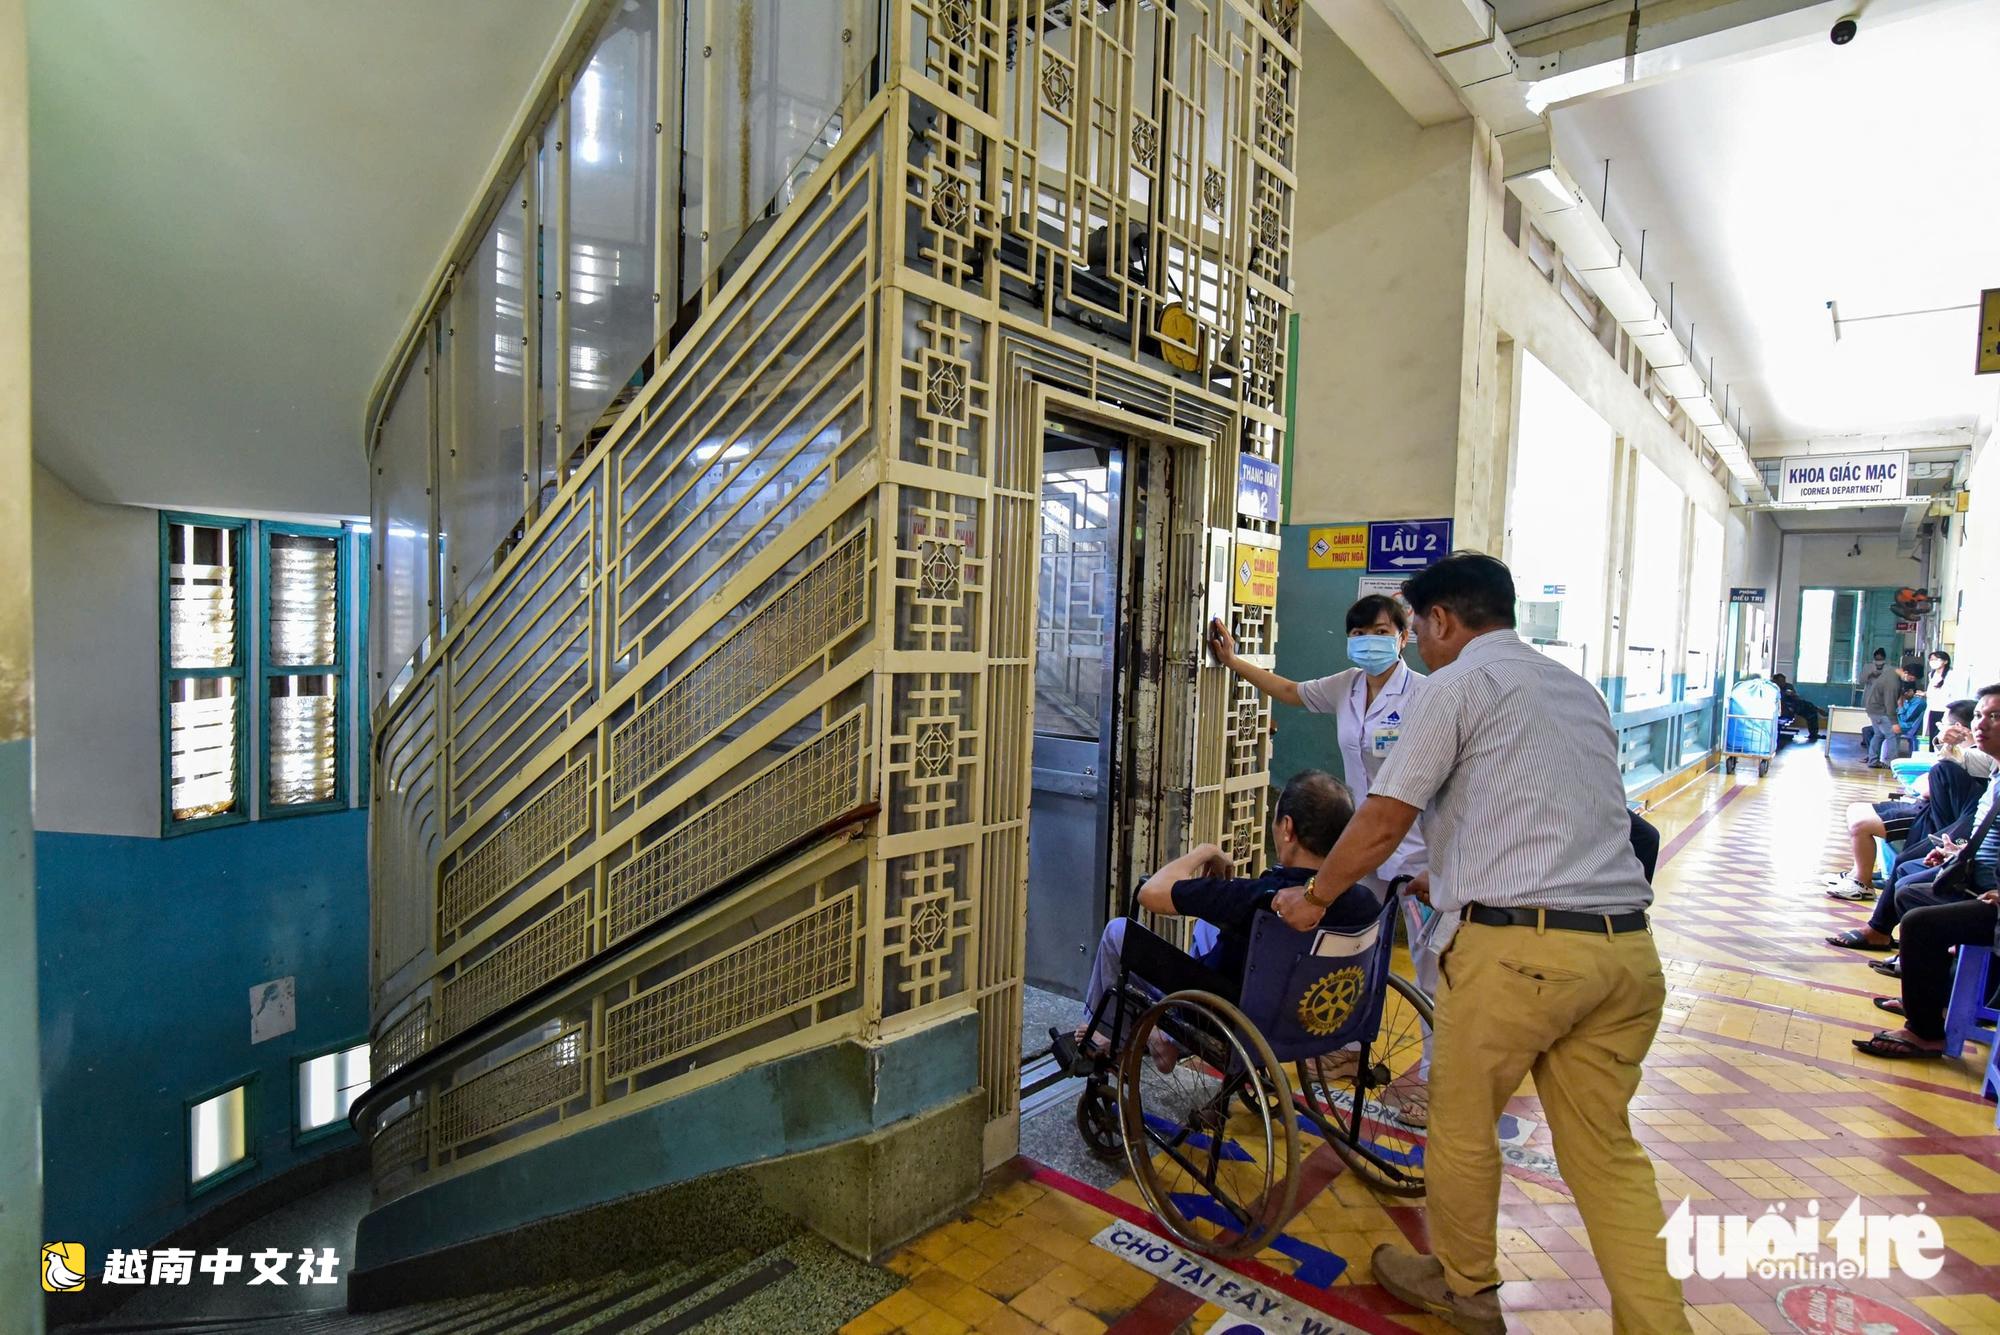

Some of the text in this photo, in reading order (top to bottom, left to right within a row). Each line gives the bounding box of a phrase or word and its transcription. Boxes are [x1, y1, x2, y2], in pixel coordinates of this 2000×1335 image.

[1243, 464, 1278, 488] THANG MÁY
[1789, 462, 1897, 483] KHOA GIÁC MẠC
[1801, 484, 1882, 496] (CORNEA DEPARTMENT)
[1381, 528, 1437, 552] LẦU 2
[1110, 1230, 1173, 1263] CHỜ
[1171, 1257, 1216, 1288] TẠI
[1217, 1280, 1282, 1318] ĐÂY
